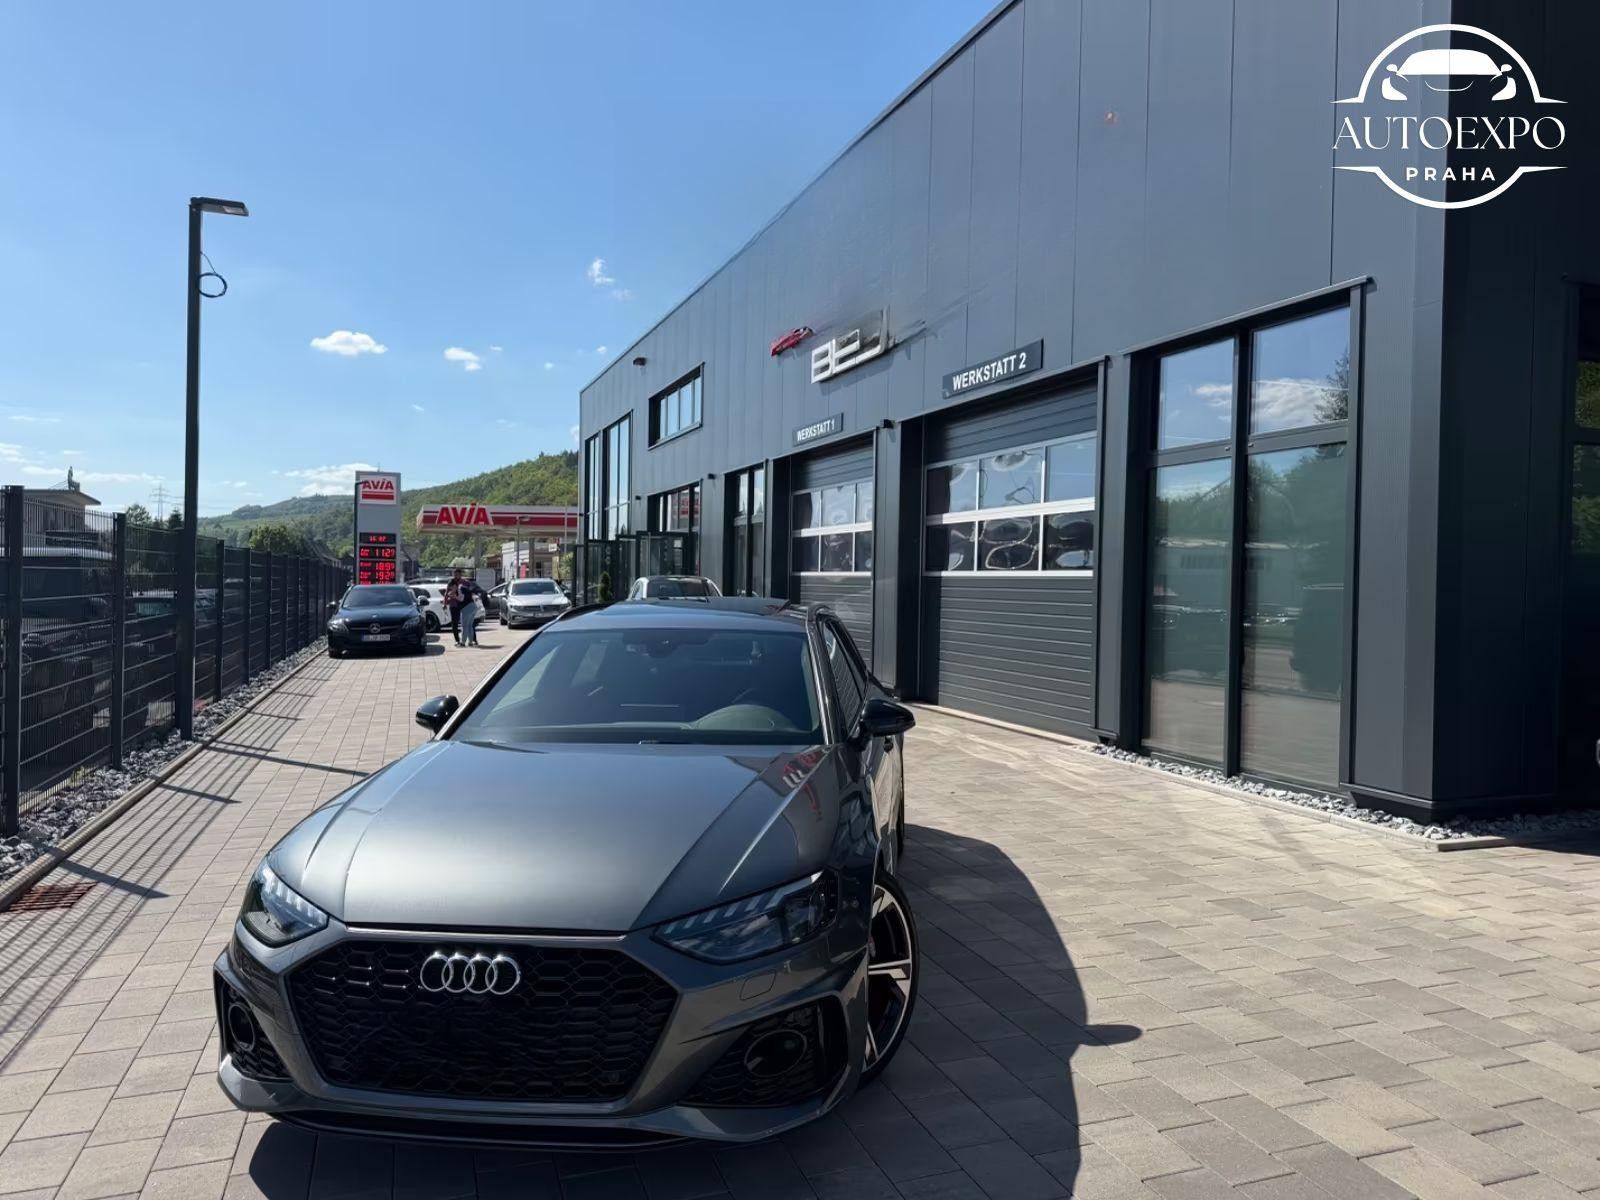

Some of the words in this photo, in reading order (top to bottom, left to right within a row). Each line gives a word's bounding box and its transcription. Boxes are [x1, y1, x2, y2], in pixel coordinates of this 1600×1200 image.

[952, 354, 1017, 391] WERKSTATT
[1019, 352, 1027, 370] 2
[797, 419, 831, 441] WERKSTATT
[361, 478, 394, 490] AVIA
[436, 501, 494, 526] AVIA
